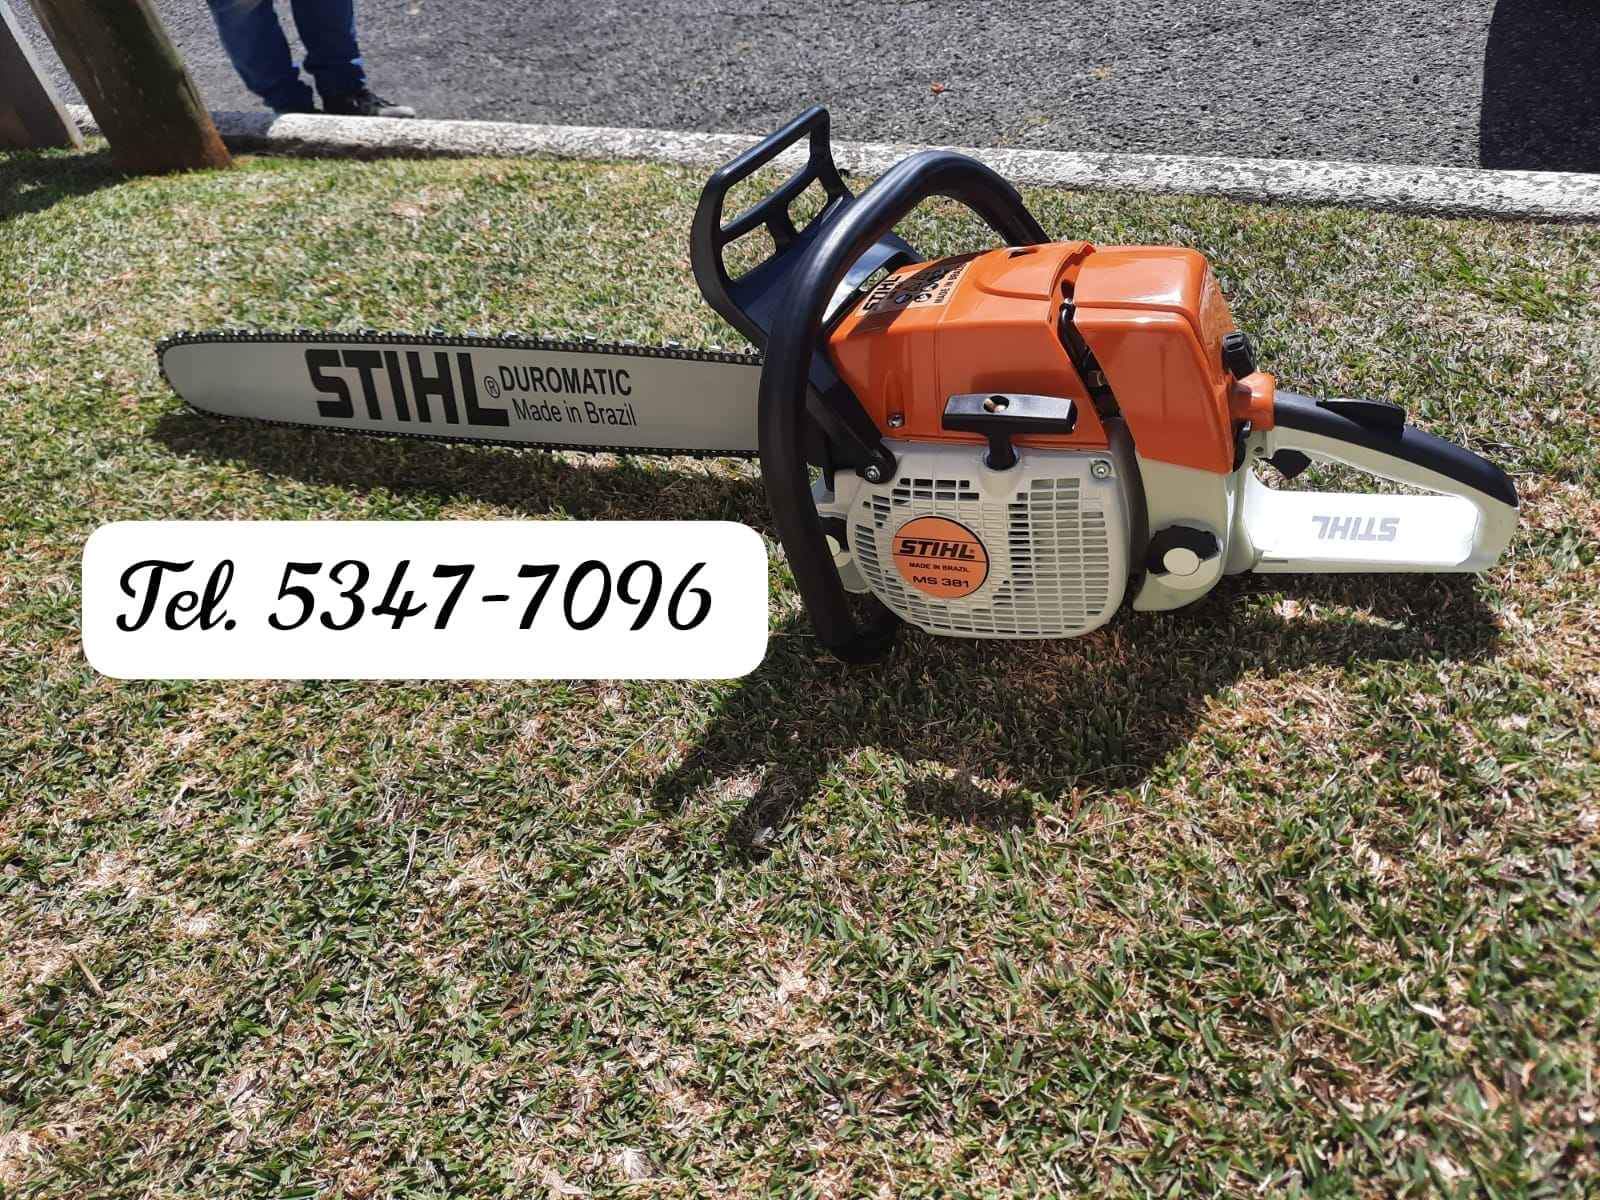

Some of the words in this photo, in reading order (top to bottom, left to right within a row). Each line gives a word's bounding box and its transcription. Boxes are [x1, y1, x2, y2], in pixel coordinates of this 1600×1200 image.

[863, 275, 902, 311] STIHL
[499, 365, 632, 396] DUROMATIC
[512, 399, 561, 422] Made
[564, 405, 582, 423] in
[587, 402, 637, 427] Brazil
[1312, 515, 1401, 543] STIHL
[900, 539, 976, 560] STIHL
[909, 562, 930, 571] MADE
[942, 565, 971, 574] BRAZIL
[912, 575, 938, 585] MS
[941, 578, 970, 589] 381
